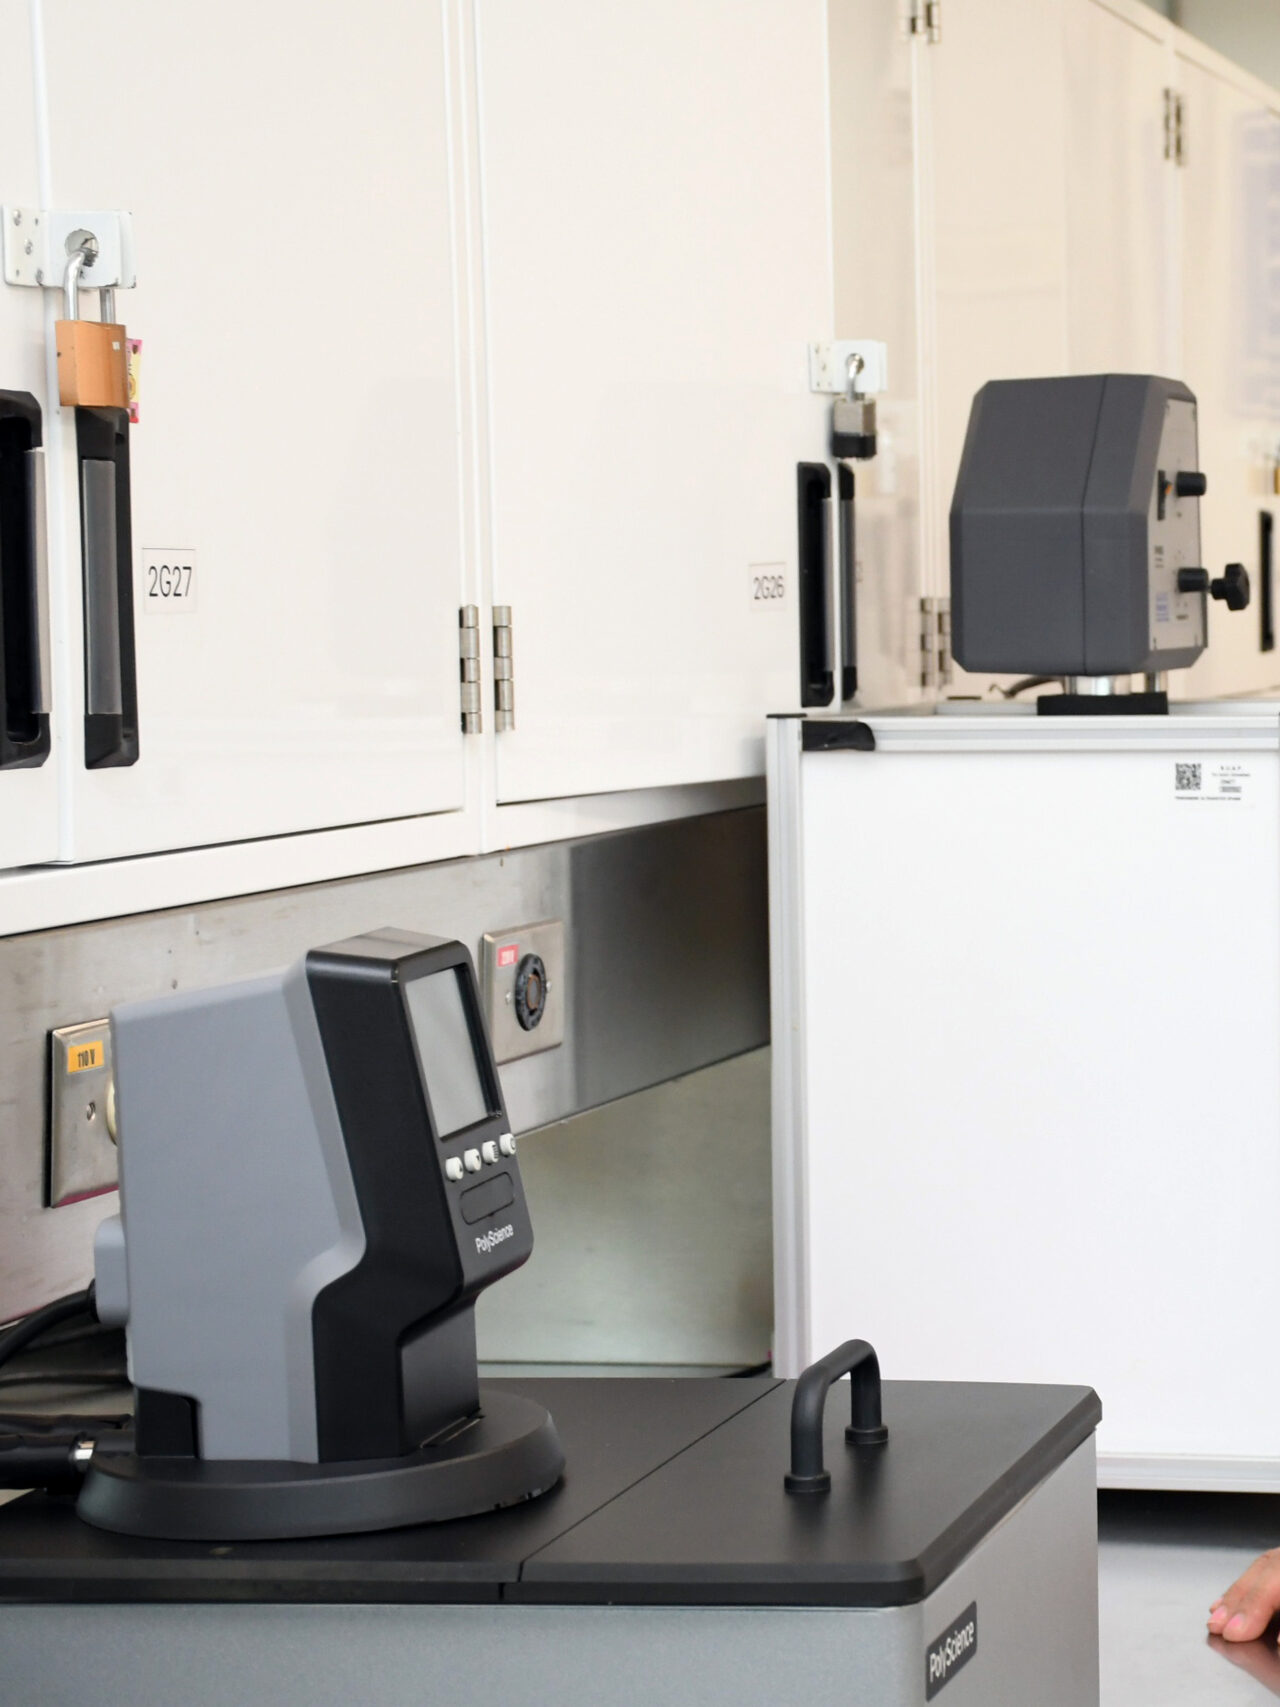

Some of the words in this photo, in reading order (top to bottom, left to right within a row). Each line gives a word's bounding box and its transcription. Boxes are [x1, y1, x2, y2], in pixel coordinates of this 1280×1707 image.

[148, 565, 192, 597] 2G27
[753, 575, 785, 600] 2G26
[475, 1224, 514, 1254] PolyScience
[929, 1621, 974, 1683] PolyScience
